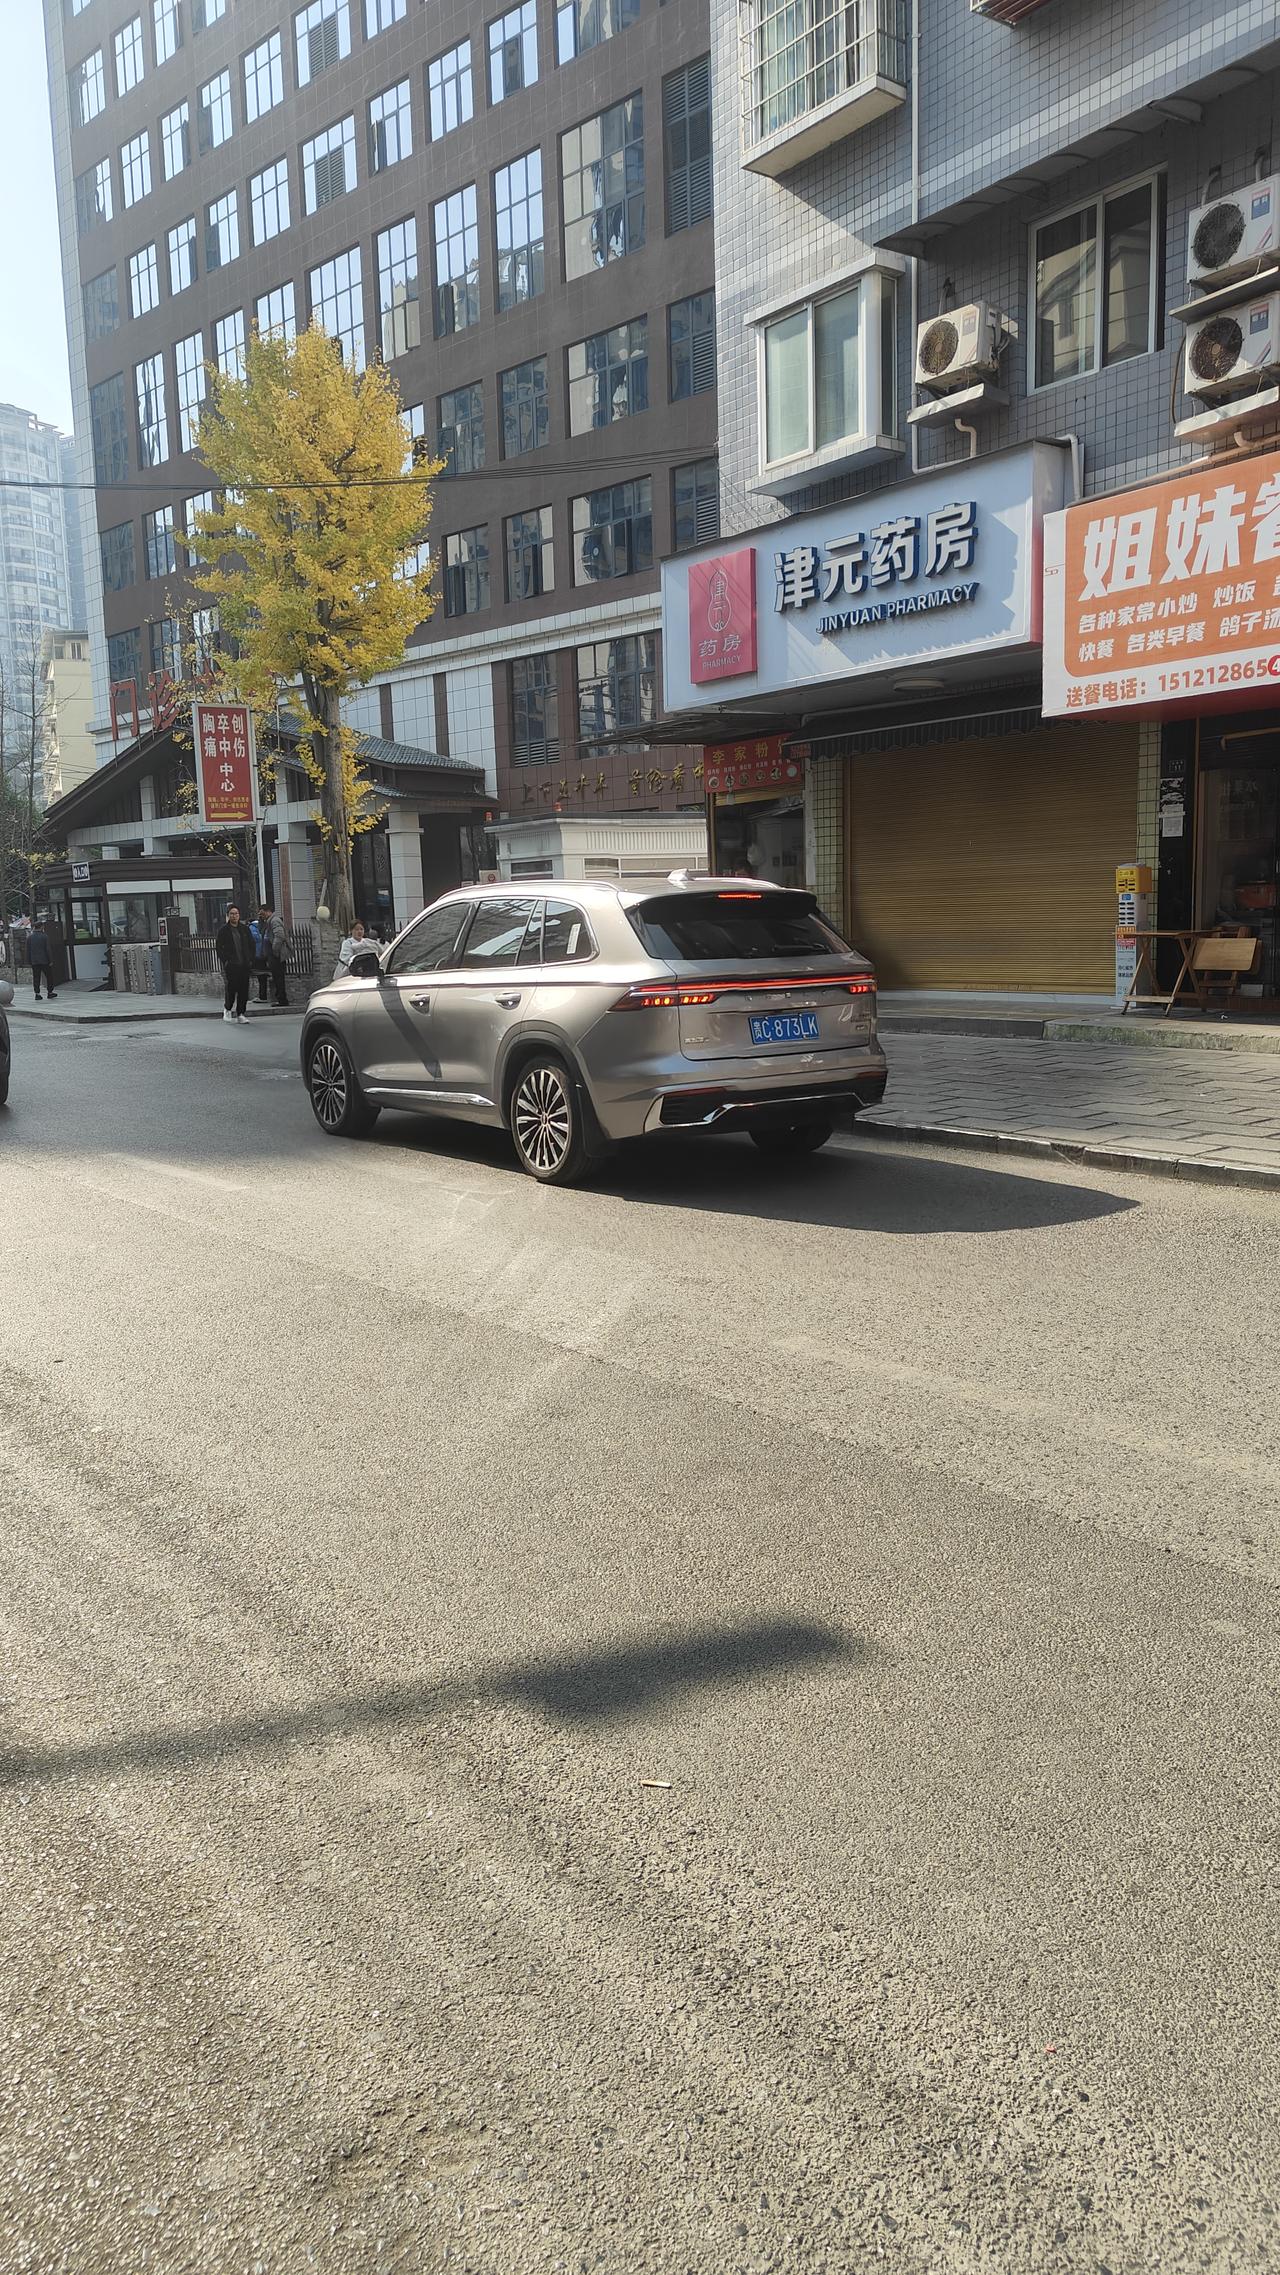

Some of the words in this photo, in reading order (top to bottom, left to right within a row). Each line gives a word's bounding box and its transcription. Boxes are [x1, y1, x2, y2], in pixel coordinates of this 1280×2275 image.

[774, 501, 979, 612] 津元药房
[815, 604, 883, 634] JINYUAN
[886, 582, 980, 618] PHARMACY
[1079, 592, 1198, 634] 各种家常小炒
[1212, 581, 1257, 609] 炒饭
[699, 634, 742, 658] 药房
[702, 655, 742, 670] PHARMACY
[1078, 638, 1115, 663] 快餐
[1127, 621, 1206, 654] 各类早餐
[219, 762, 235, 792] 中心
